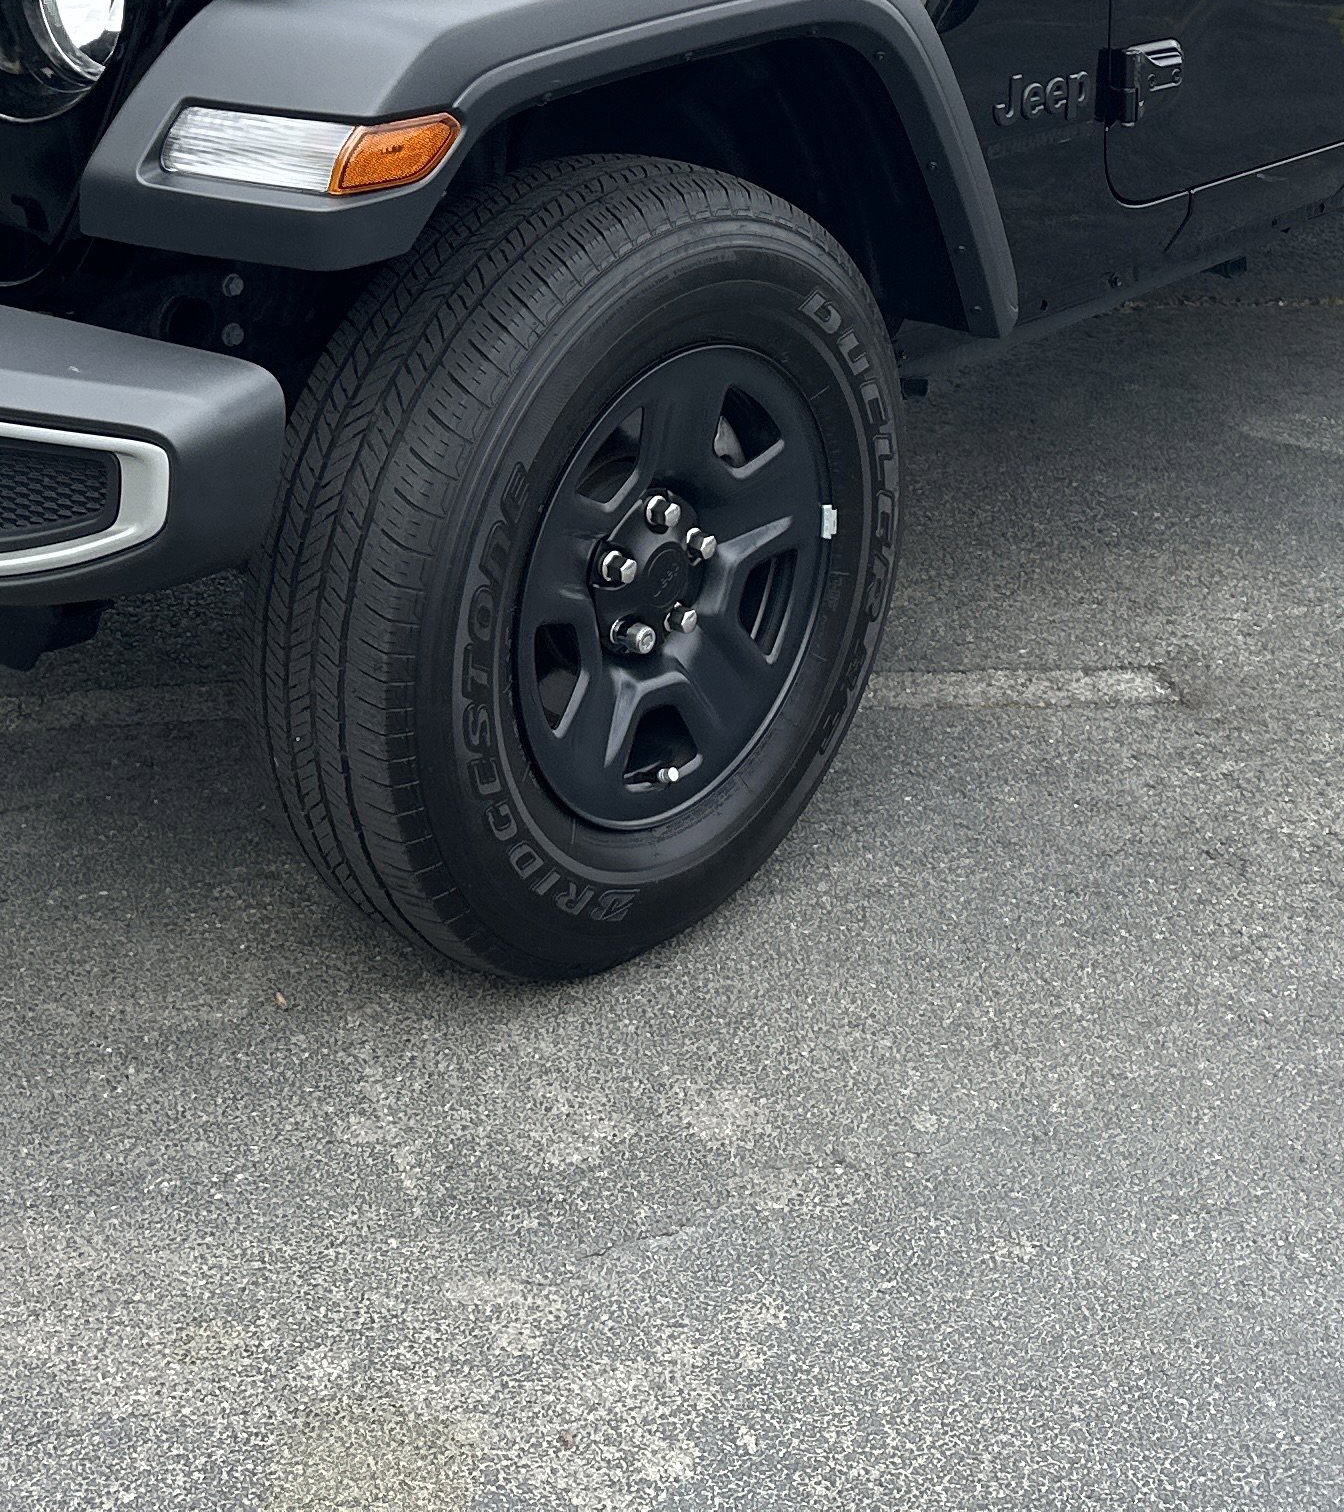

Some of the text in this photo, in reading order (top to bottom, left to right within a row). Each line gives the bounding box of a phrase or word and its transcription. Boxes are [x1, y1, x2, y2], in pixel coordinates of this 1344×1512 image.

[992, 71, 1091, 126] Jeep
[796, 289, 895, 623] DUELER
[462, 461, 640, 922] BRIDGESTONE
